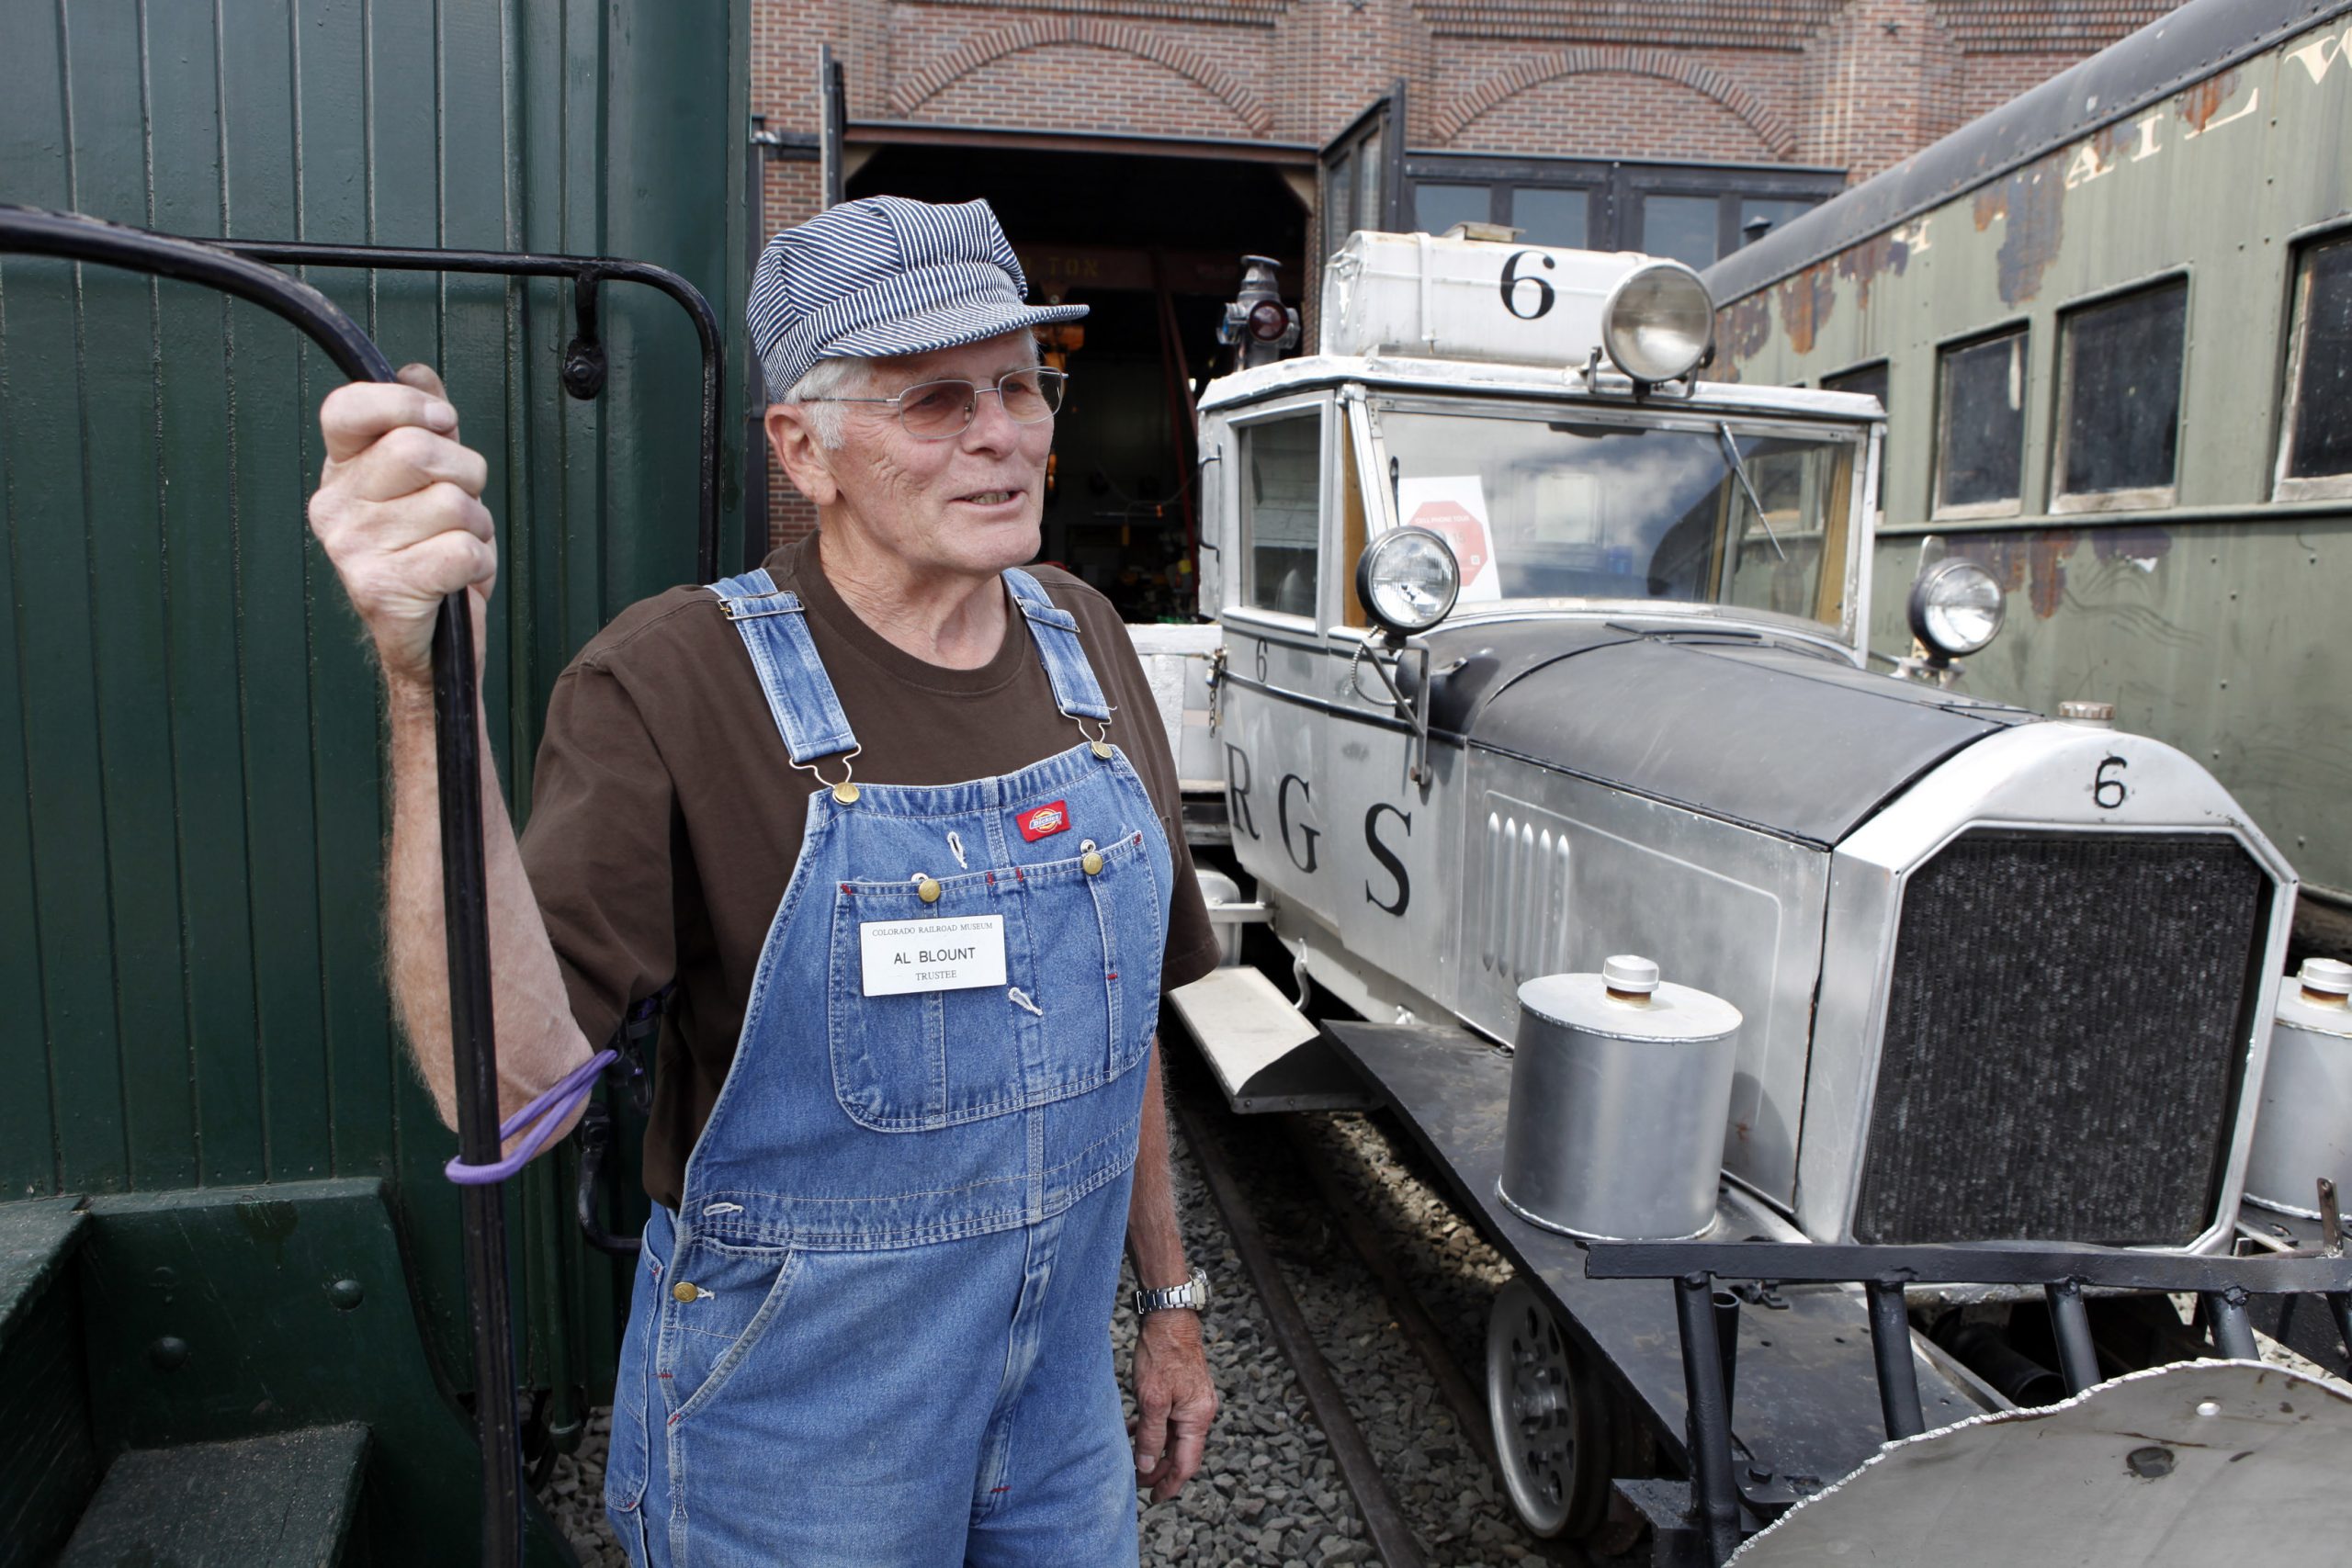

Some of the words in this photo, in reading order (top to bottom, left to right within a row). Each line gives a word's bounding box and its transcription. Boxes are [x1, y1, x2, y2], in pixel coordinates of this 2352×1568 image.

[1048, 256, 1099, 277] TON
[1500, 250, 1555, 320] 6
[1255, 637, 1268, 682] 6
[2093, 756, 2128, 809] 6
[872, 927, 915, 937] COLORADO
[919, 924, 957, 934] RAILROAD
[960, 922, 993, 931] MUSEUM
[894, 952, 911, 964] AL
[920, 947, 976, 963] BLOUNT
[915, 970, 957, 981] TRUSTEE
